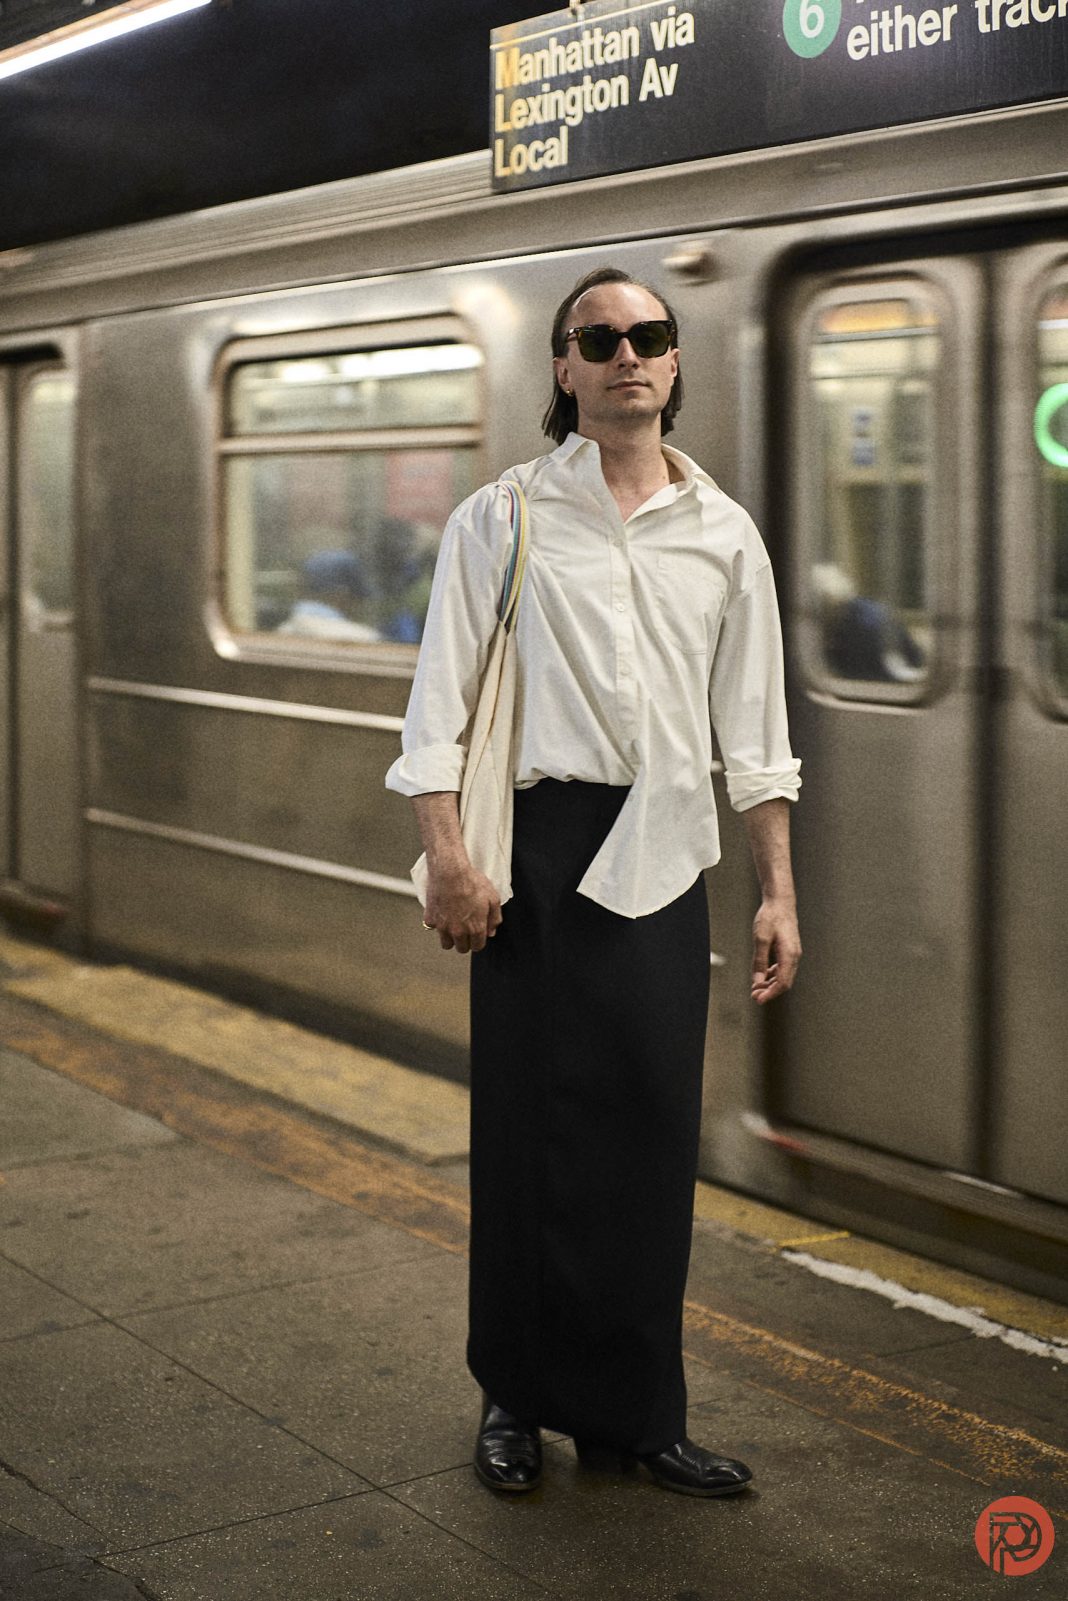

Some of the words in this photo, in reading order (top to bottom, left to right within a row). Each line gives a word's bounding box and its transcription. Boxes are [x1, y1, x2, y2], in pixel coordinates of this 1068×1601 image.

[799, 0, 825, 39] 6
[846, 5, 958, 61] either
[495, 26, 640, 90] Manhattan
[650, 6, 695, 51] via
[494, 75, 629, 133] Lexington
[638, 57, 679, 102] Av
[494, 125, 568, 177] Local
